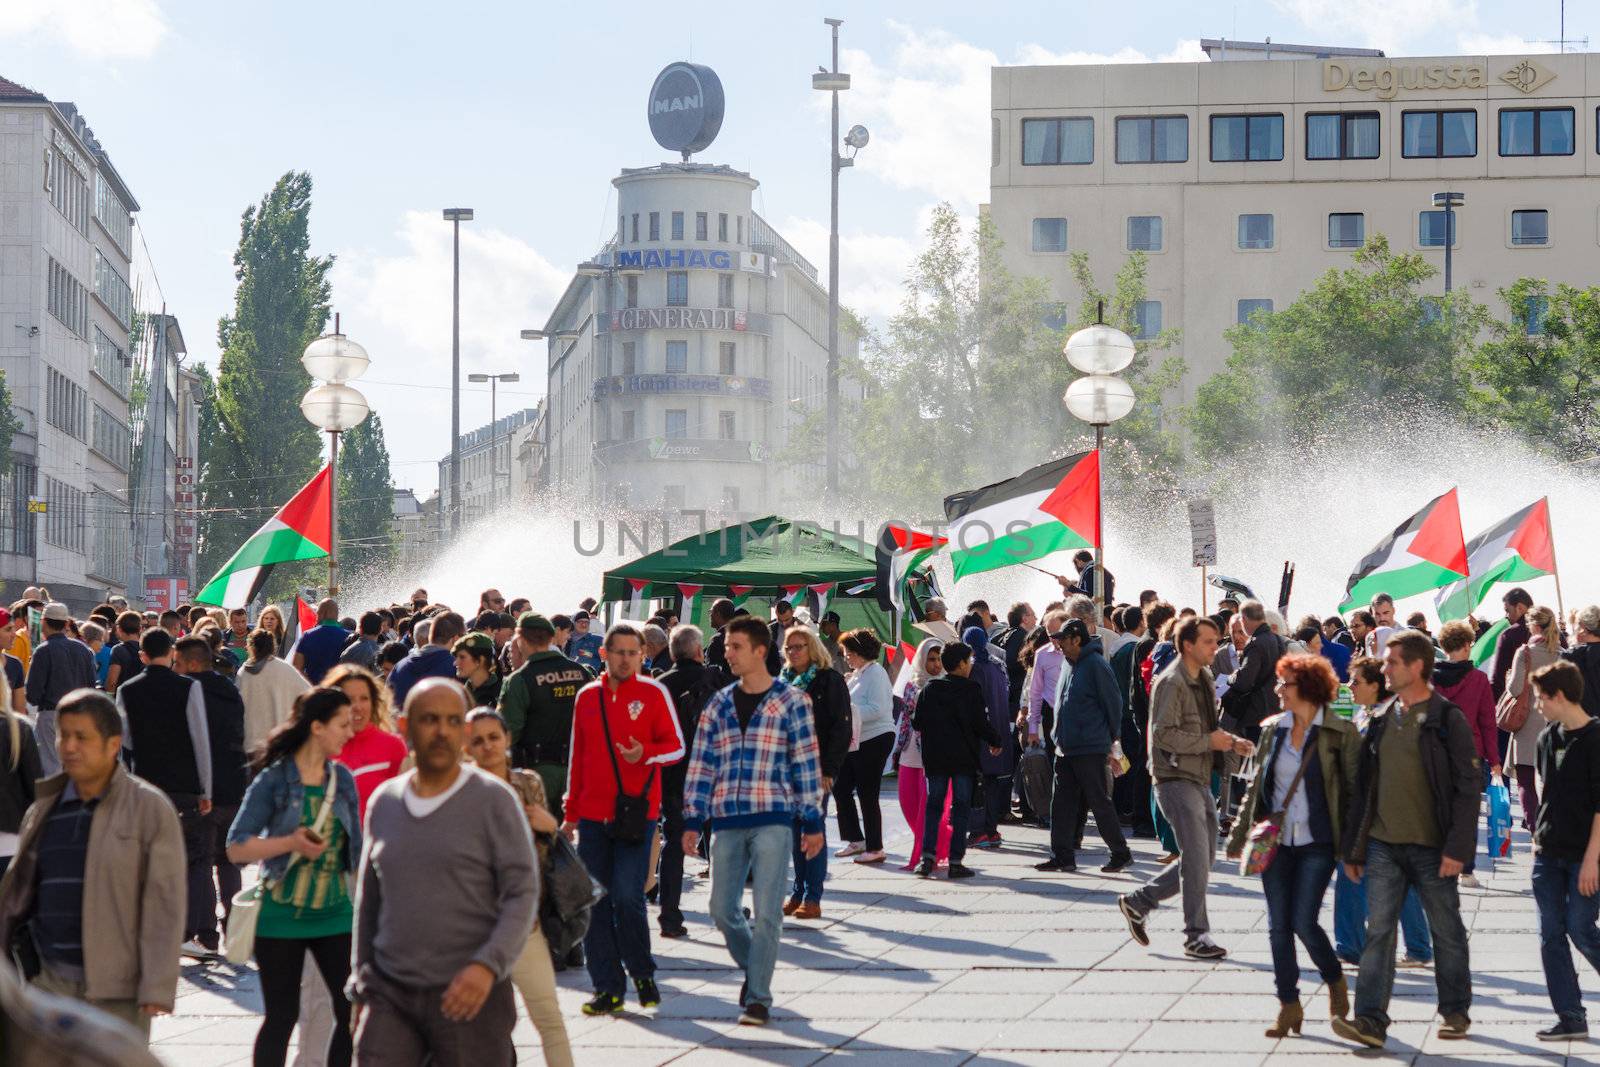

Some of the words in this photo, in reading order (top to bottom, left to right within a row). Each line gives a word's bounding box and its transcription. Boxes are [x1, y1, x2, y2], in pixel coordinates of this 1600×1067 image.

[1322, 60, 1487, 99] Degussa
[655, 95, 698, 114] MAN
[620, 249, 730, 268] MAHAG
[621, 309, 730, 330] GENERALI
[536, 670, 584, 687] POLIZEI
